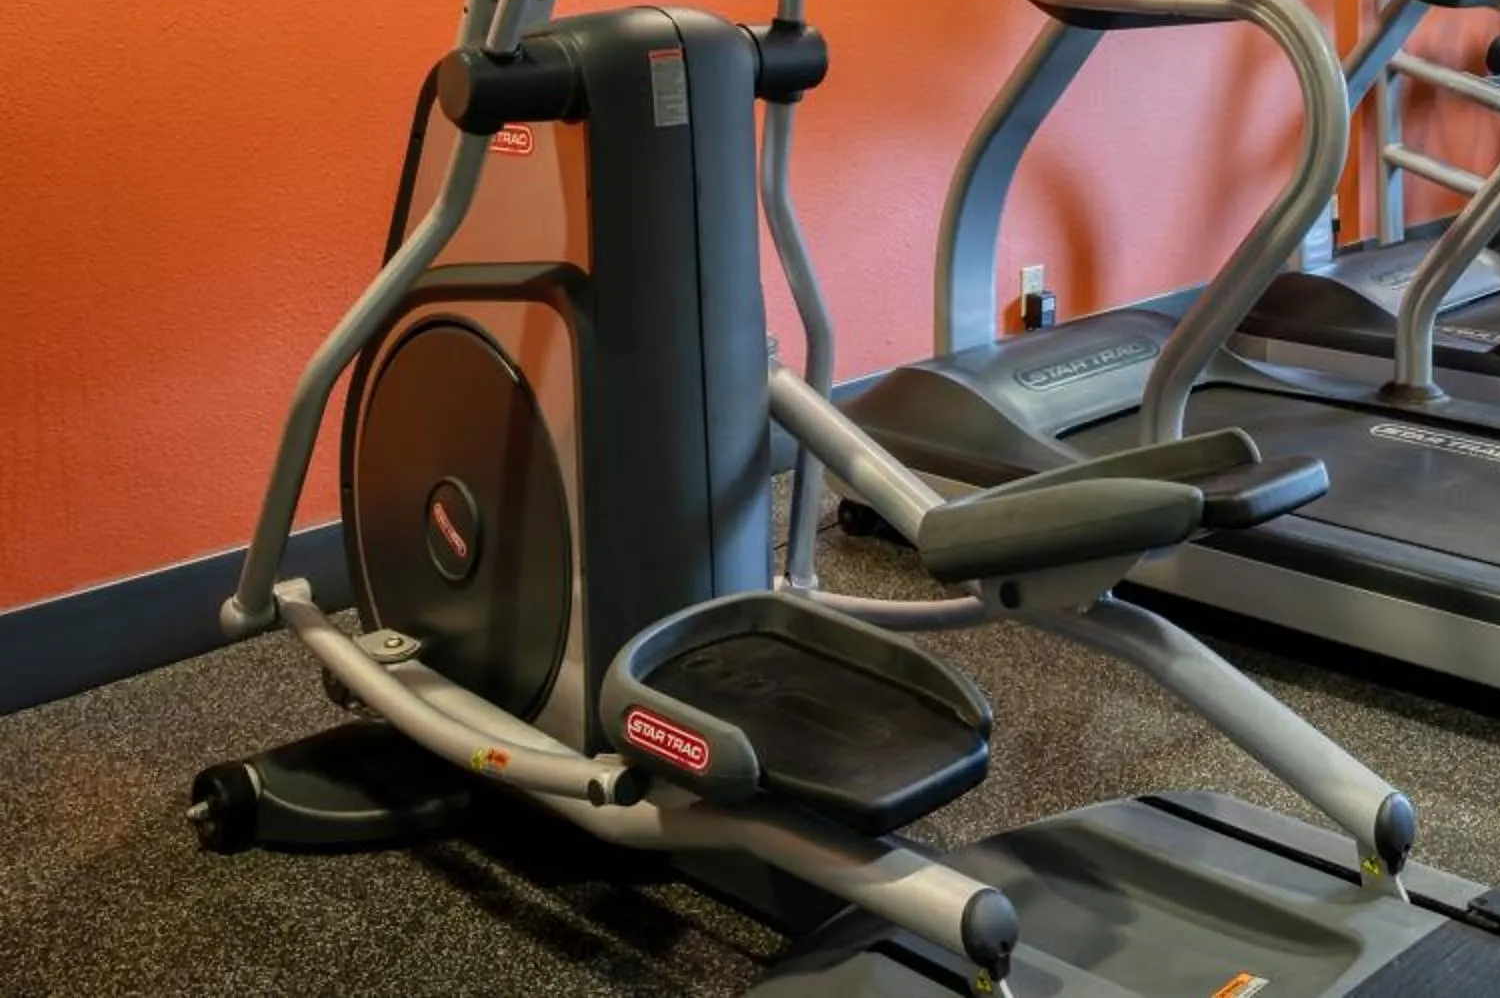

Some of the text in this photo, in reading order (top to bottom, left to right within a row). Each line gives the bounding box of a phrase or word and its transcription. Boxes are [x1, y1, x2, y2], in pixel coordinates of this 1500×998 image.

[1028, 342, 1145, 384] STAR TRAC
[631, 719, 702, 761] STAR TRAC
